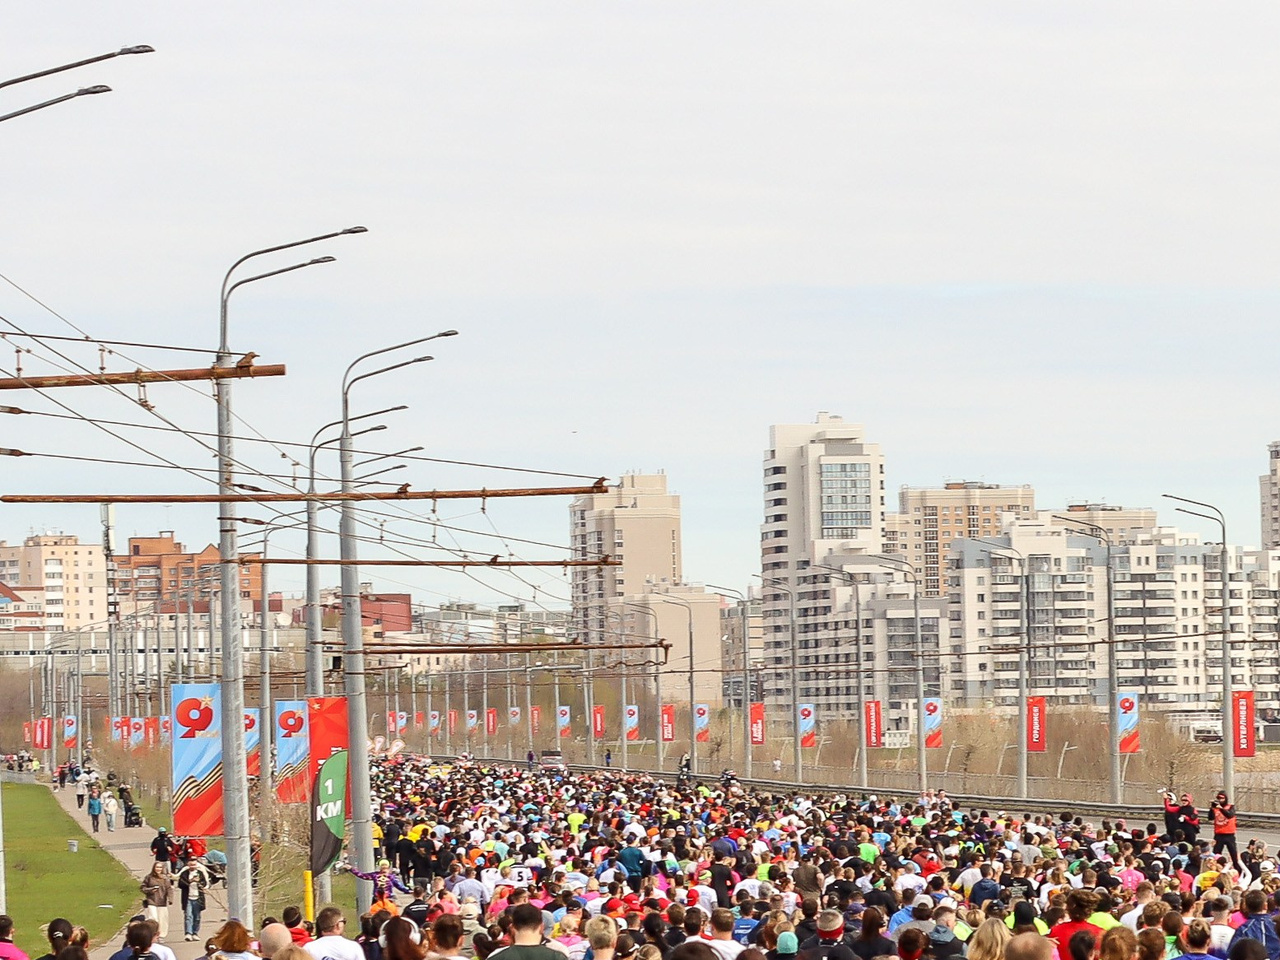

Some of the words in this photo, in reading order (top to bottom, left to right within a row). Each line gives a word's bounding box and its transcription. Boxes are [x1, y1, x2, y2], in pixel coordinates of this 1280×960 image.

[1119, 697, 1135, 714] 9
[175, 697, 214, 739] 9
[278, 710, 304, 738] 9
[324, 778, 333, 795] 1
[517, 871, 524, 882] 5
